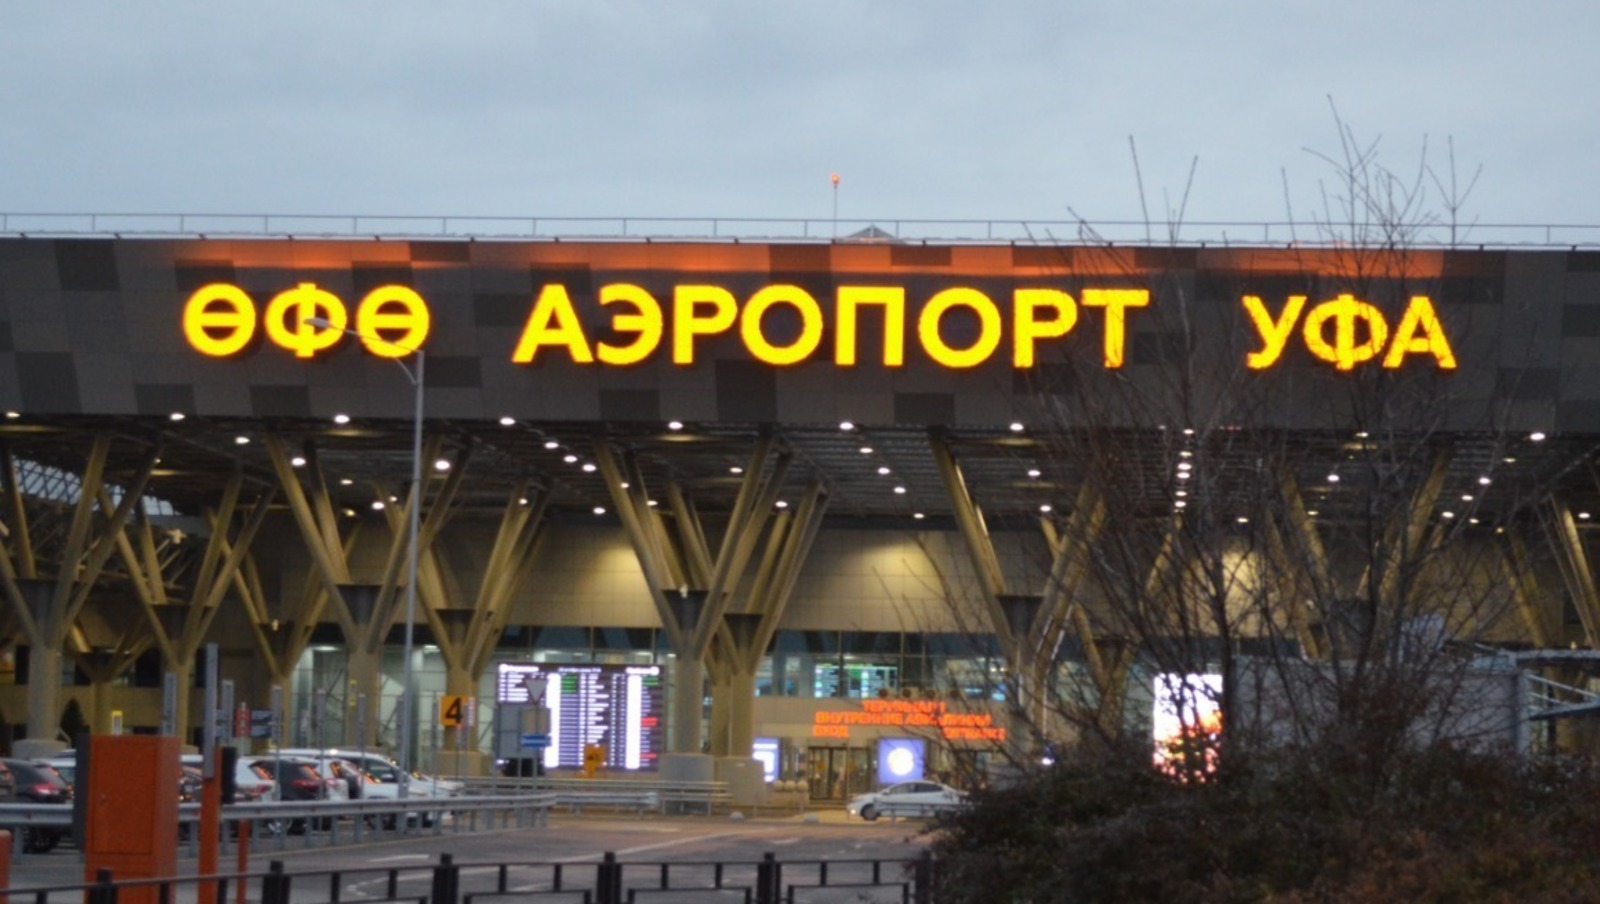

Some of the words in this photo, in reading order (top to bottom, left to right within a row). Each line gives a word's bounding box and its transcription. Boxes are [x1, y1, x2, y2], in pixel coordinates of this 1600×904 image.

[512, 285, 1149, 367] АЭРОПОРТ
[1243, 294, 1456, 369] УФА
[446, 698, 463, 724] 4
